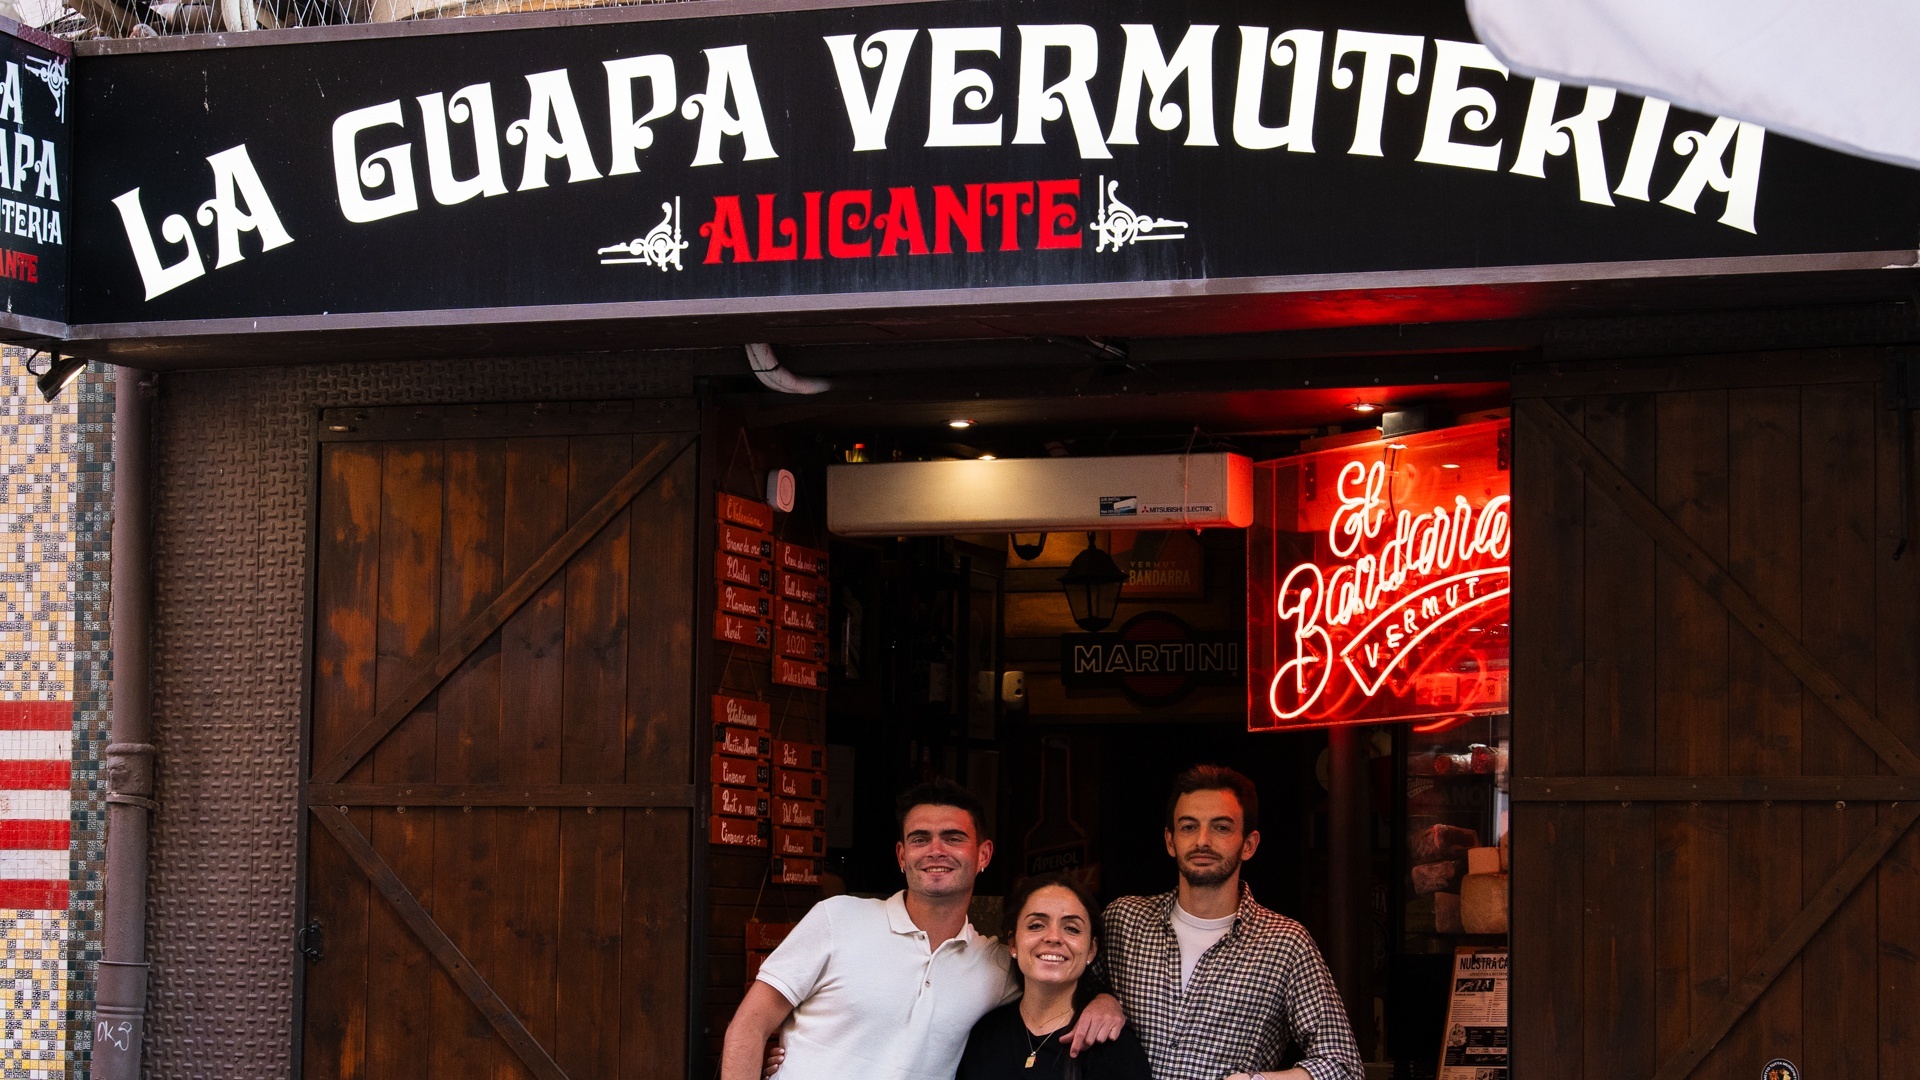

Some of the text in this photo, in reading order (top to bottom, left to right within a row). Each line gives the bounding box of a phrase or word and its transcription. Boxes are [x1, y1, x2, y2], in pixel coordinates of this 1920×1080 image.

[112, 23, 1758, 302] LA GUAPA VERMUTERIA
[0, 197, 63, 245] TERIA
[698, 179, 1083, 265] ALICANTE
[1129, 569, 1191, 586] BANDARRA
[1130, 561, 1177, 569] VERMUT
[1364, 576, 1481, 668] VERMUT
[786, 633, 806, 655] 1020
[1073, 643, 1239, 674] MARTINI
[1031, 850, 1080, 874] APEROL
[1459, 957, 1497, 970] NUESTRA
